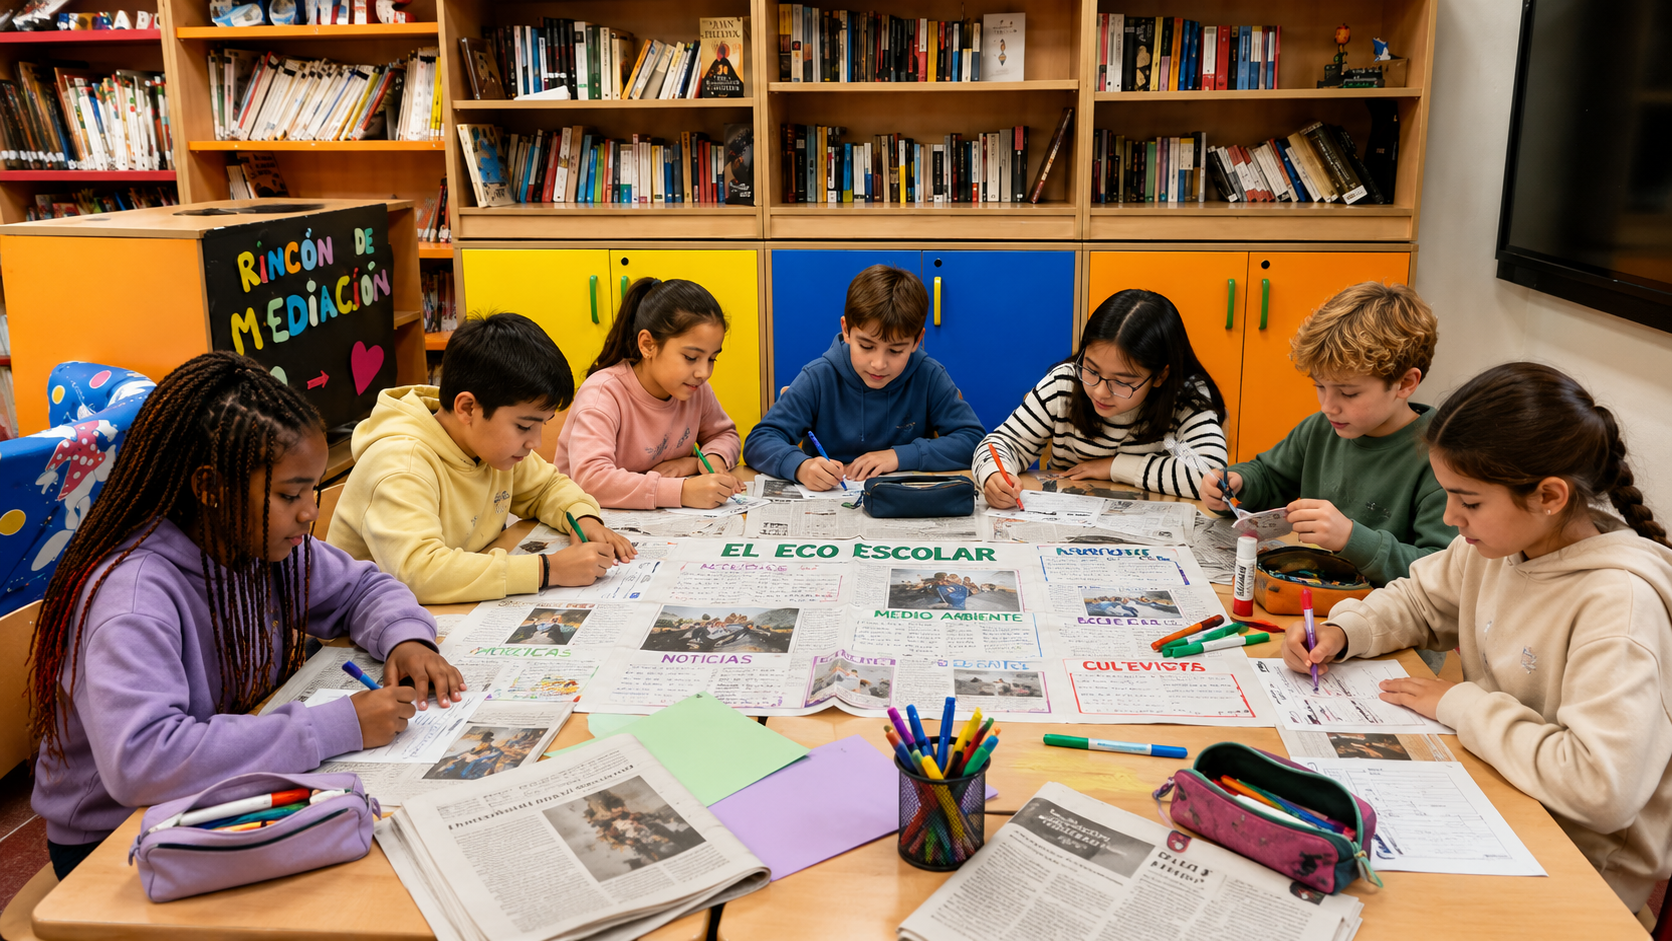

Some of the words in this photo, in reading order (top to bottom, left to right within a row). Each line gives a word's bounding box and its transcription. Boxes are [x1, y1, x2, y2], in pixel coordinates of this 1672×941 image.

[354, 228, 375, 256] DE
[720, 543, 760, 558] EL
[774, 543, 840, 559] ECO
[852, 543, 998, 562] ESCOLAR
[873, 610, 934, 620] MEDIO
[660, 653, 753, 665] NOTICIAS
